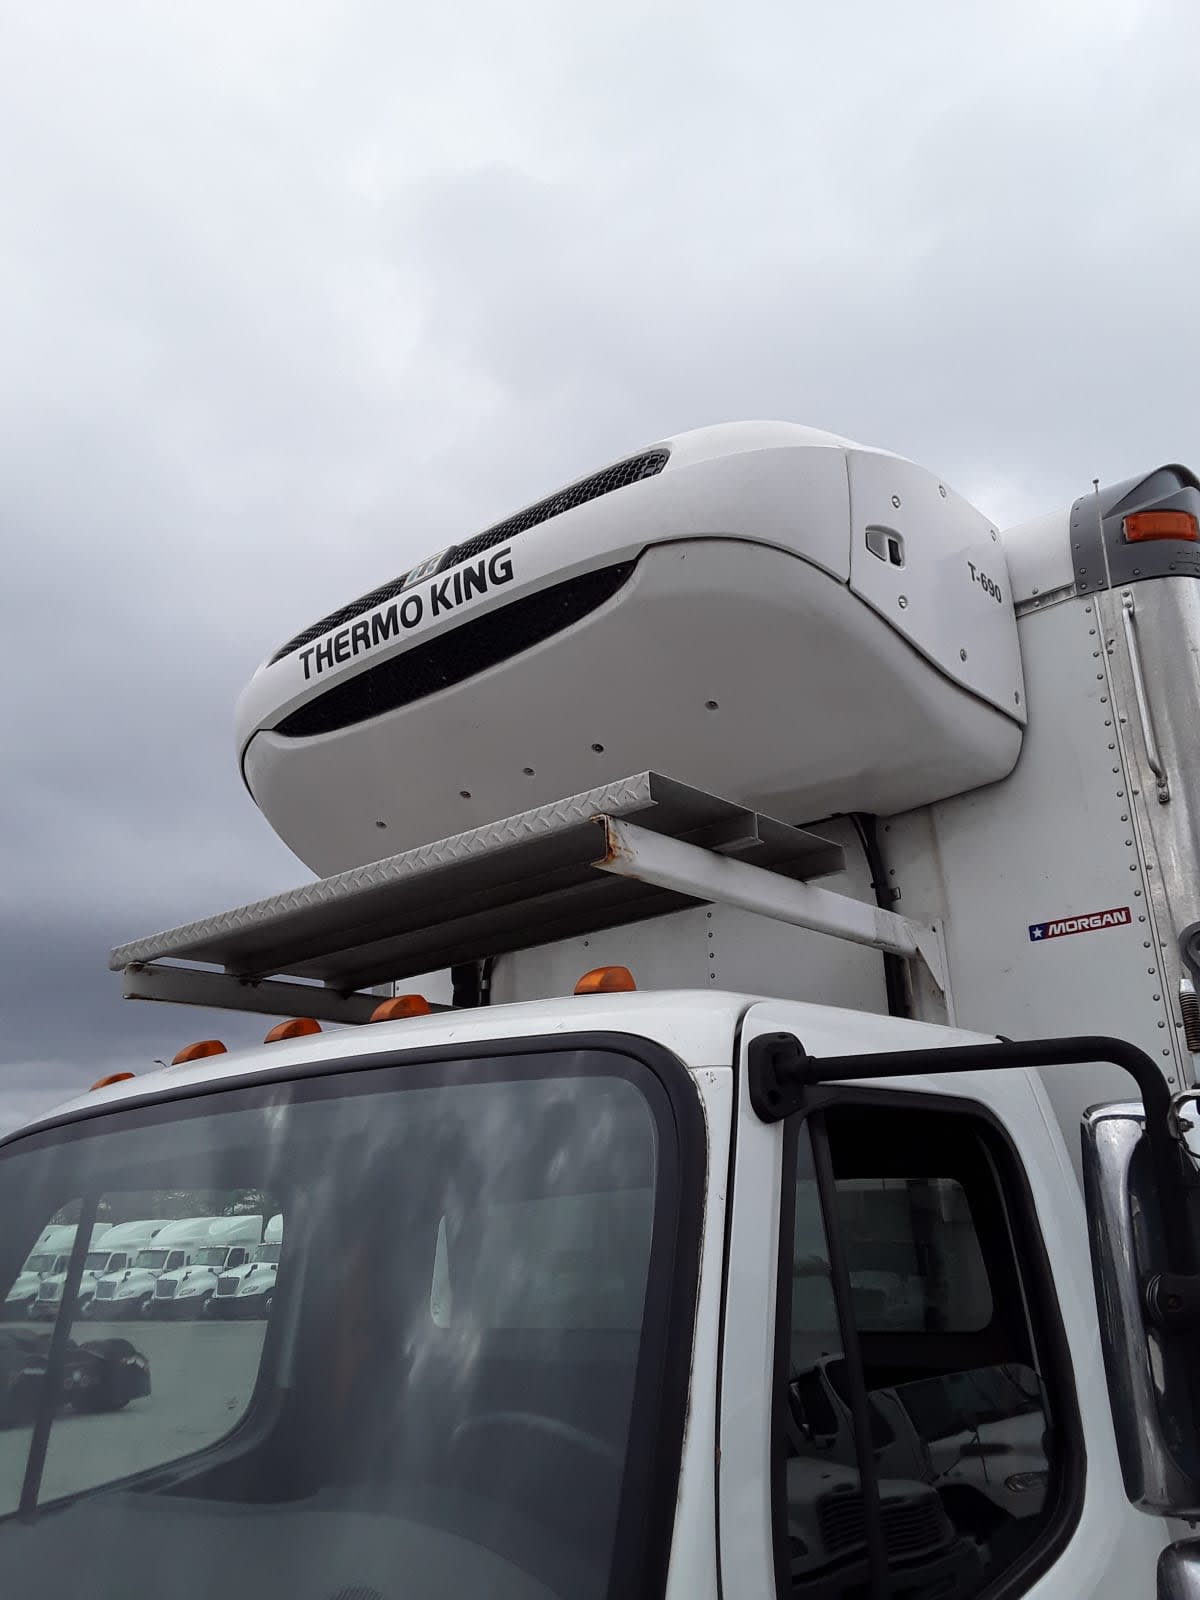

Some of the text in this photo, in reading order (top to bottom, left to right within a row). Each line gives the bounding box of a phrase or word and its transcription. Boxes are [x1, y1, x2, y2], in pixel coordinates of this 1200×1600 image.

[967, 561, 1002, 604] T-690
[299, 547, 514, 680] THERMO KING
[1048, 910, 1127, 936] MORGAN
